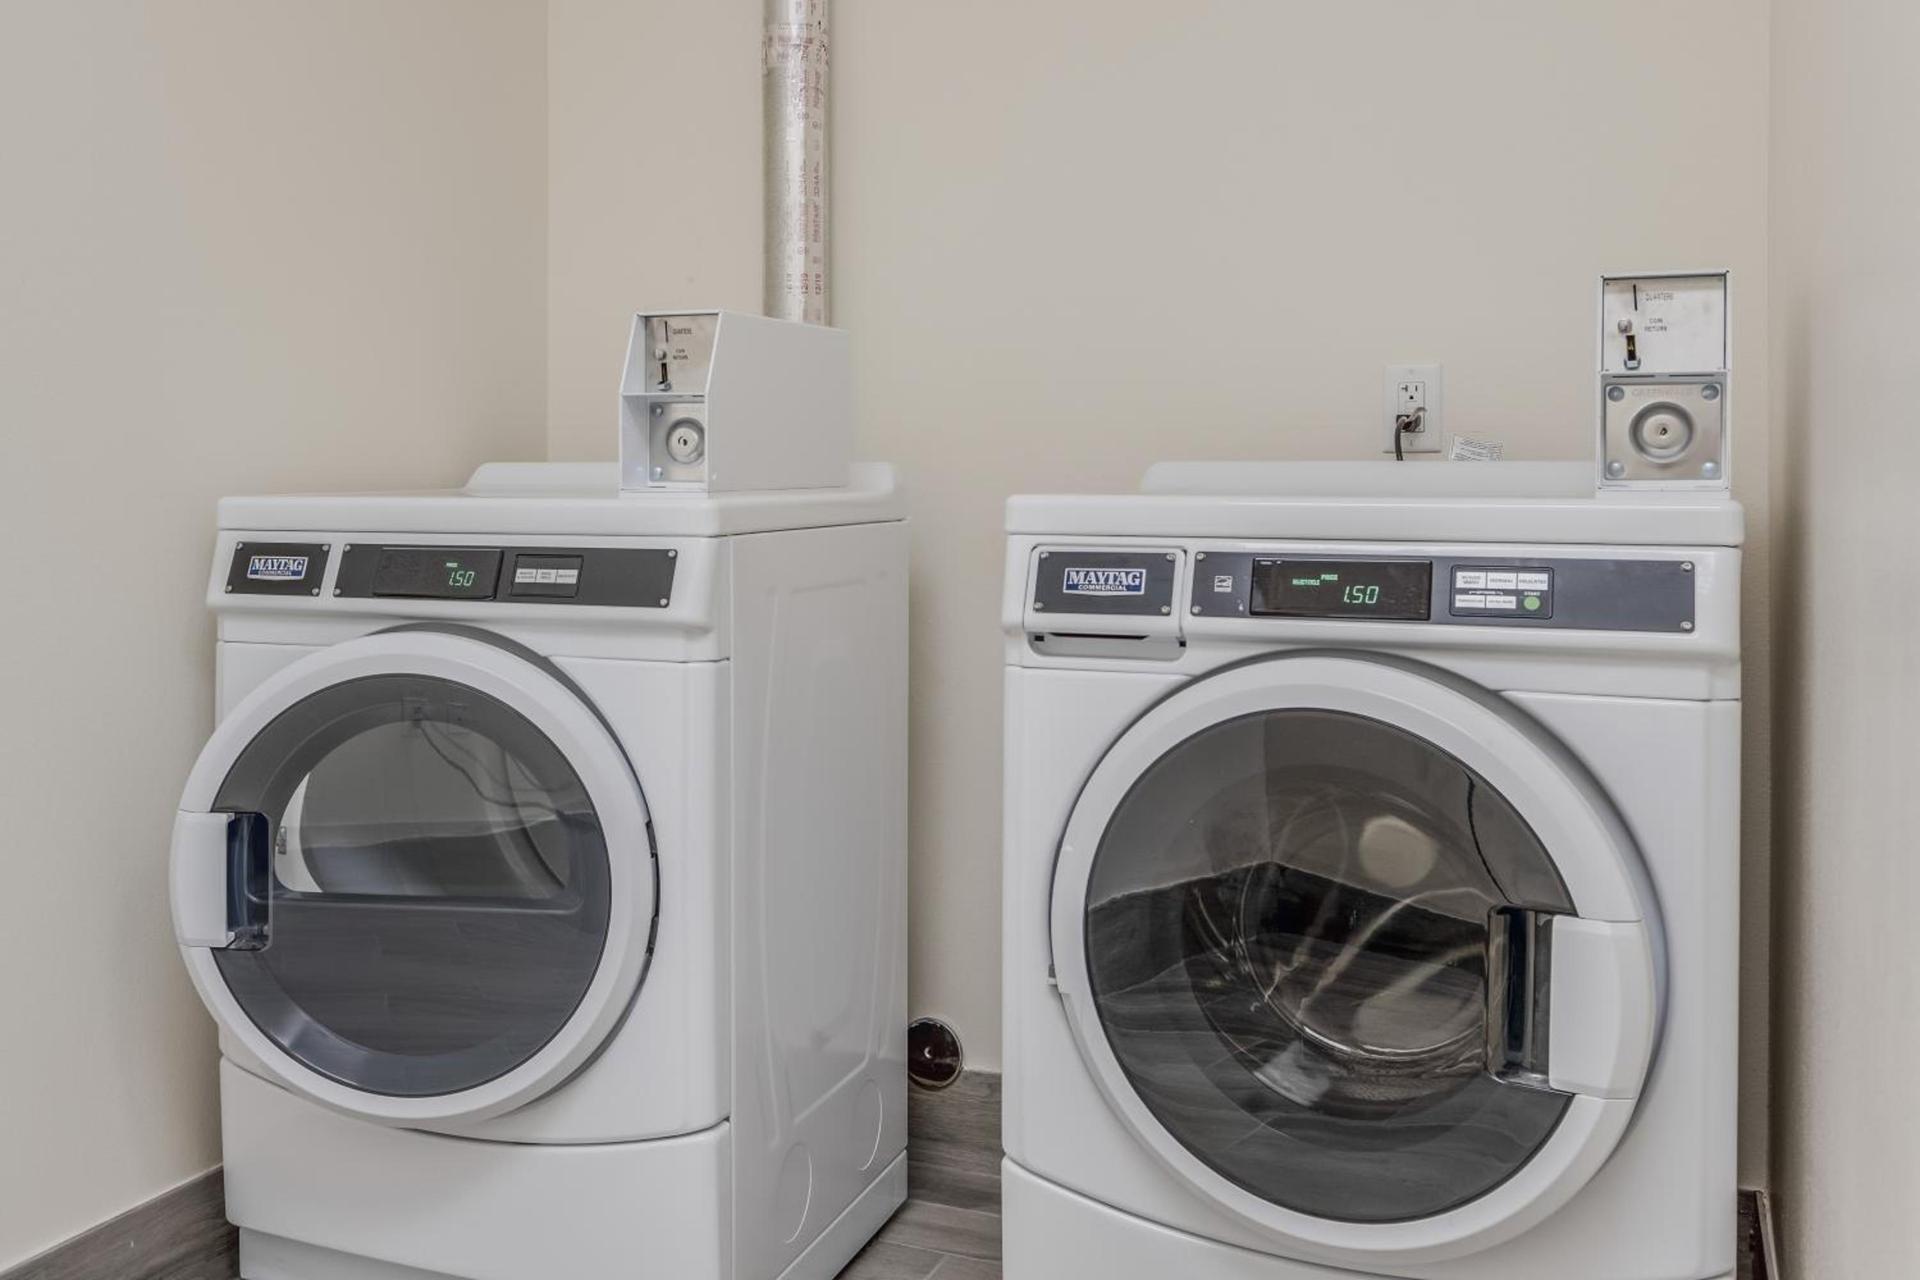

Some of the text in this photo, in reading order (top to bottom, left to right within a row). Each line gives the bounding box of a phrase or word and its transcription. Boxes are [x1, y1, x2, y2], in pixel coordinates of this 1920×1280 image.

[252, 559, 303, 571] MAYTAG
[1067, 571, 1140, 586] MAYTAG
[1078, 584, 1128, 592] COMMERCIAL
